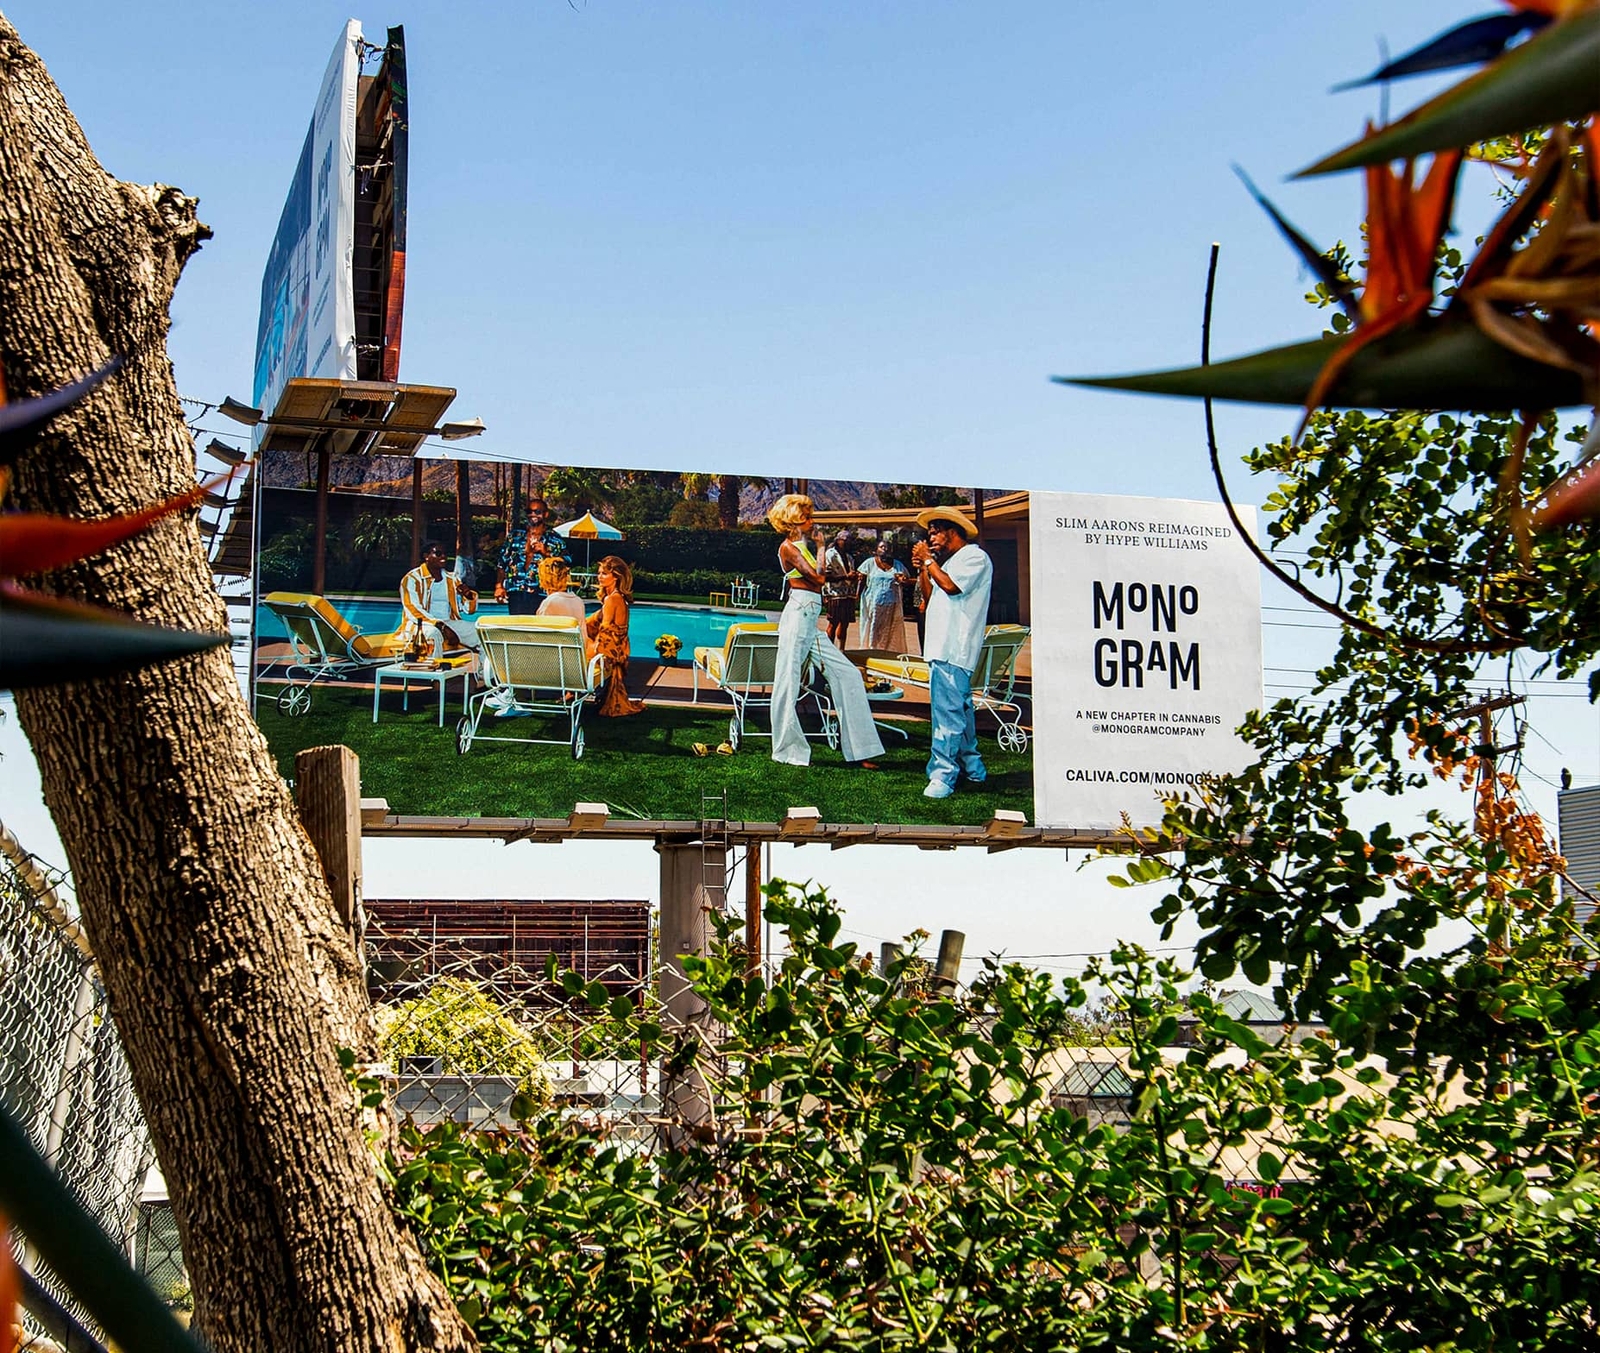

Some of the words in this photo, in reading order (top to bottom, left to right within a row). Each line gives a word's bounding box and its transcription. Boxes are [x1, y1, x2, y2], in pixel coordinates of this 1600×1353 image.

[1055, 517, 1087, 530] SLIM
[1091, 519, 1145, 533] AARONS
[1148, 522, 1232, 539] REIMAGINED
[1085, 533, 1101, 544] BY
[1105, 534, 1140, 547] HYPE
[1143, 536, 1208, 551] WILLIAMS
[1076, 710, 1083, 720] A
[1085, 710, 1108, 720] NEW
[1110, 711, 1156, 722] CHAPTER
[1159, 713, 1169, 723] IN
[1171, 713, 1221, 725] CANNABIS
[1092, 723, 1206, 737] @MONOGRAMCOMPANY
